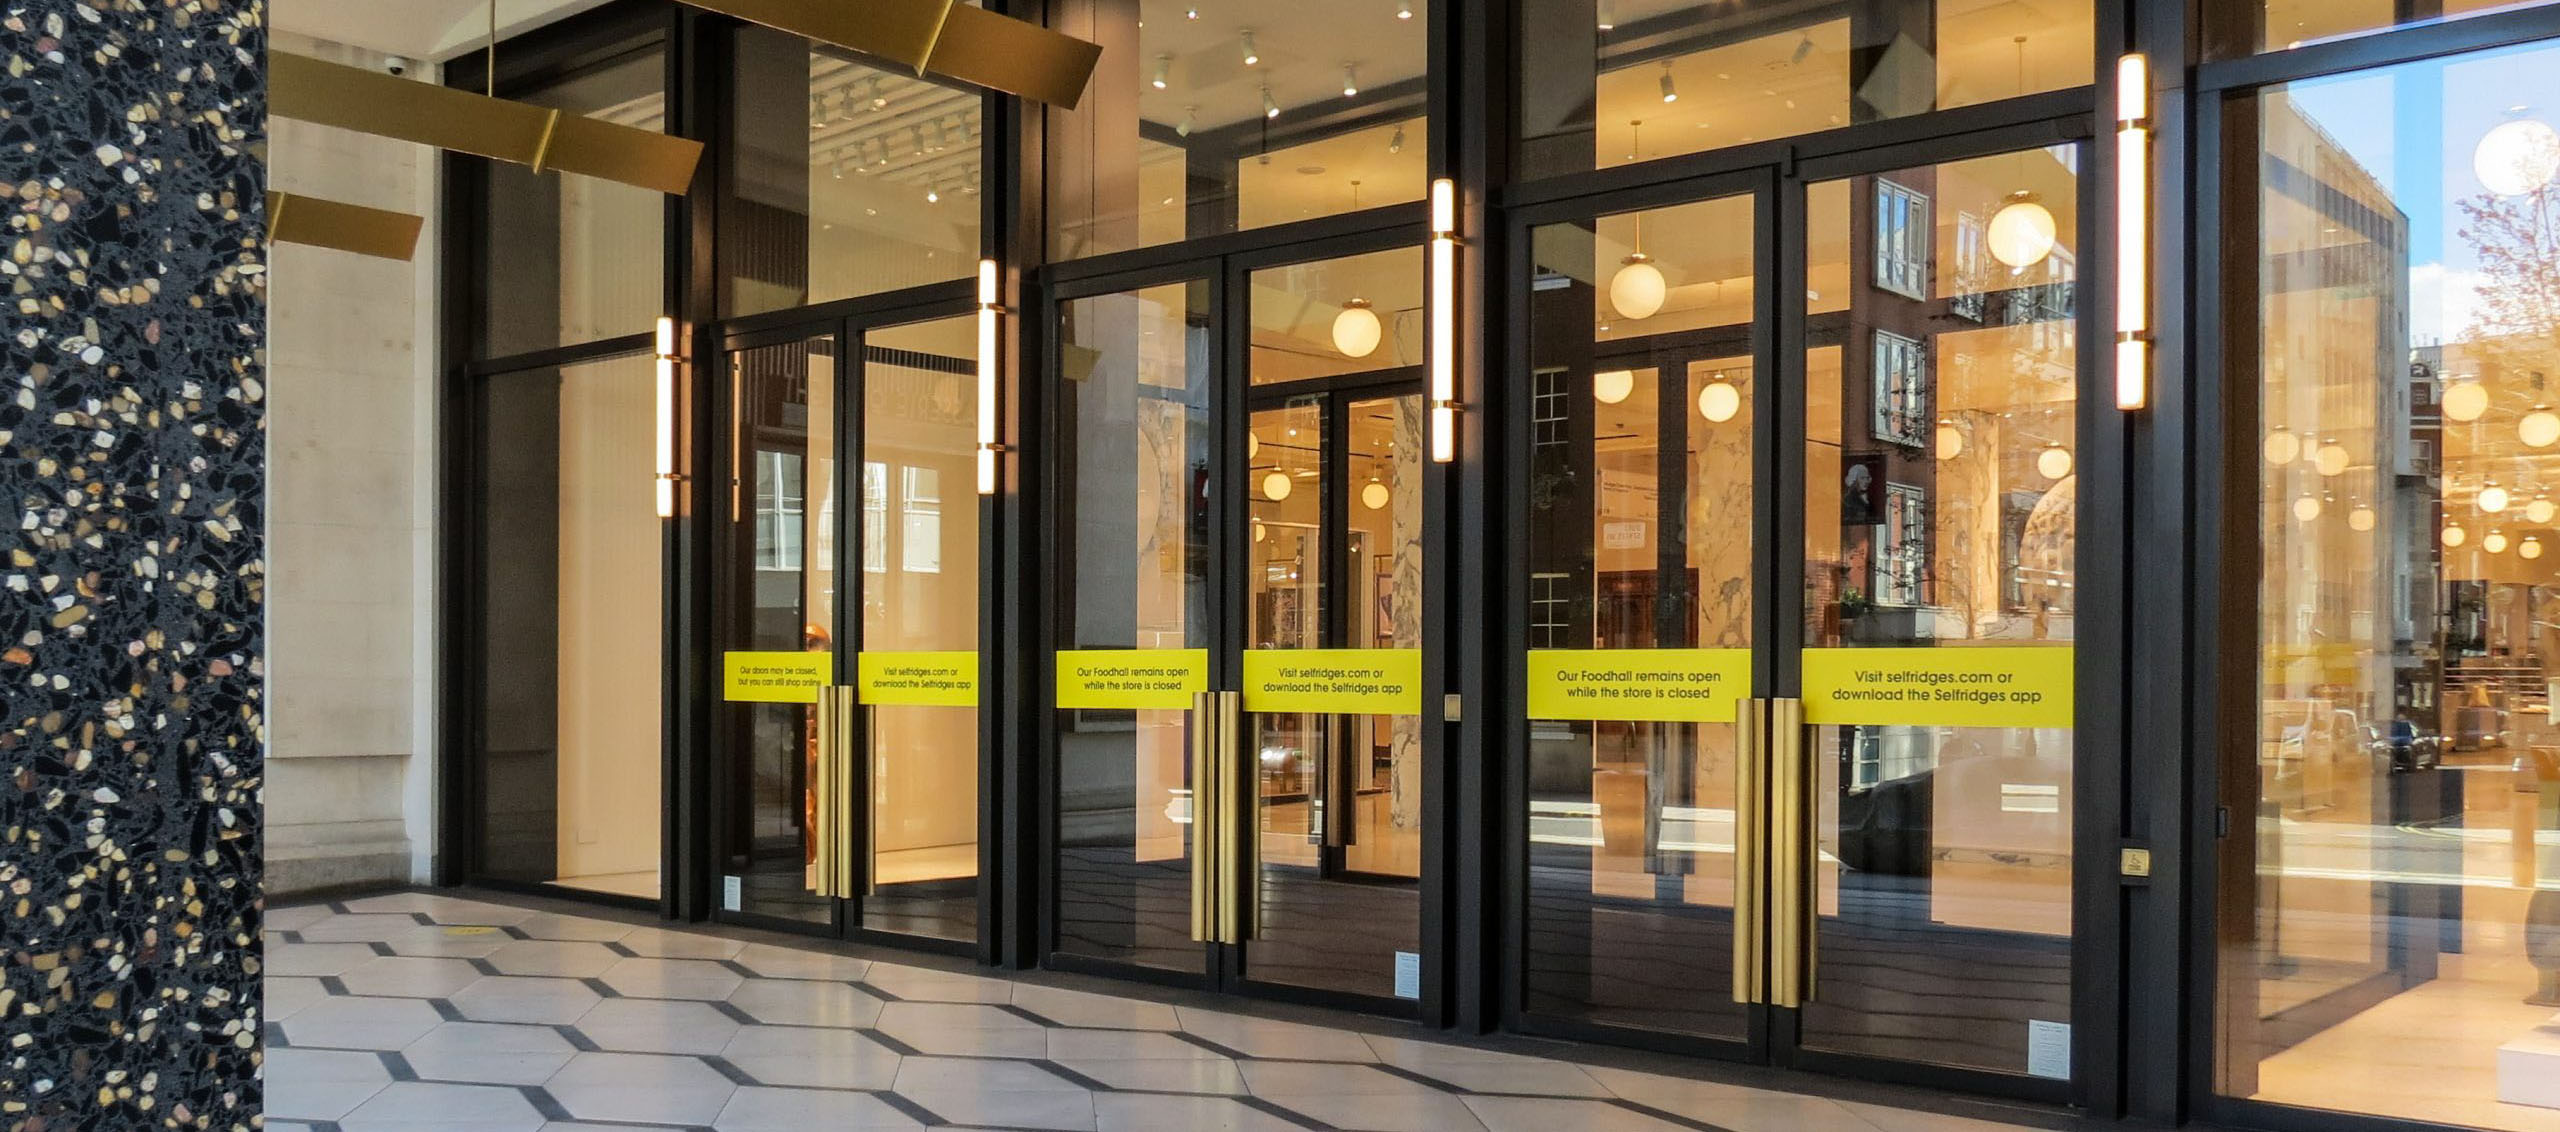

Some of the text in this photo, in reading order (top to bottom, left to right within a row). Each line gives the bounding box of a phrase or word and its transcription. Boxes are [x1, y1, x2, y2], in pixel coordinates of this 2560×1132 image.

[884, 667, 958, 678] Visit selfridges.com or
[1077, 667, 1189, 678] Our Foodhall remains open
[1278, 667, 1384, 680] Visit selfridges.com or
[1557, 670, 1721, 684] Our Foodhall remains open
[786, 678, 800, 687] shop
[1855, 671, 2013, 686] Visit selfridges.com or
[873, 680, 972, 690] download the Selfridges app
[1084, 681, 1182, 690] while the store is closed
[1264, 682, 1402, 695] download the Selfridges app
[1567, 687, 1710, 698] while the store is closed
[1832, 688, 2042, 704] download the Selfridges app
